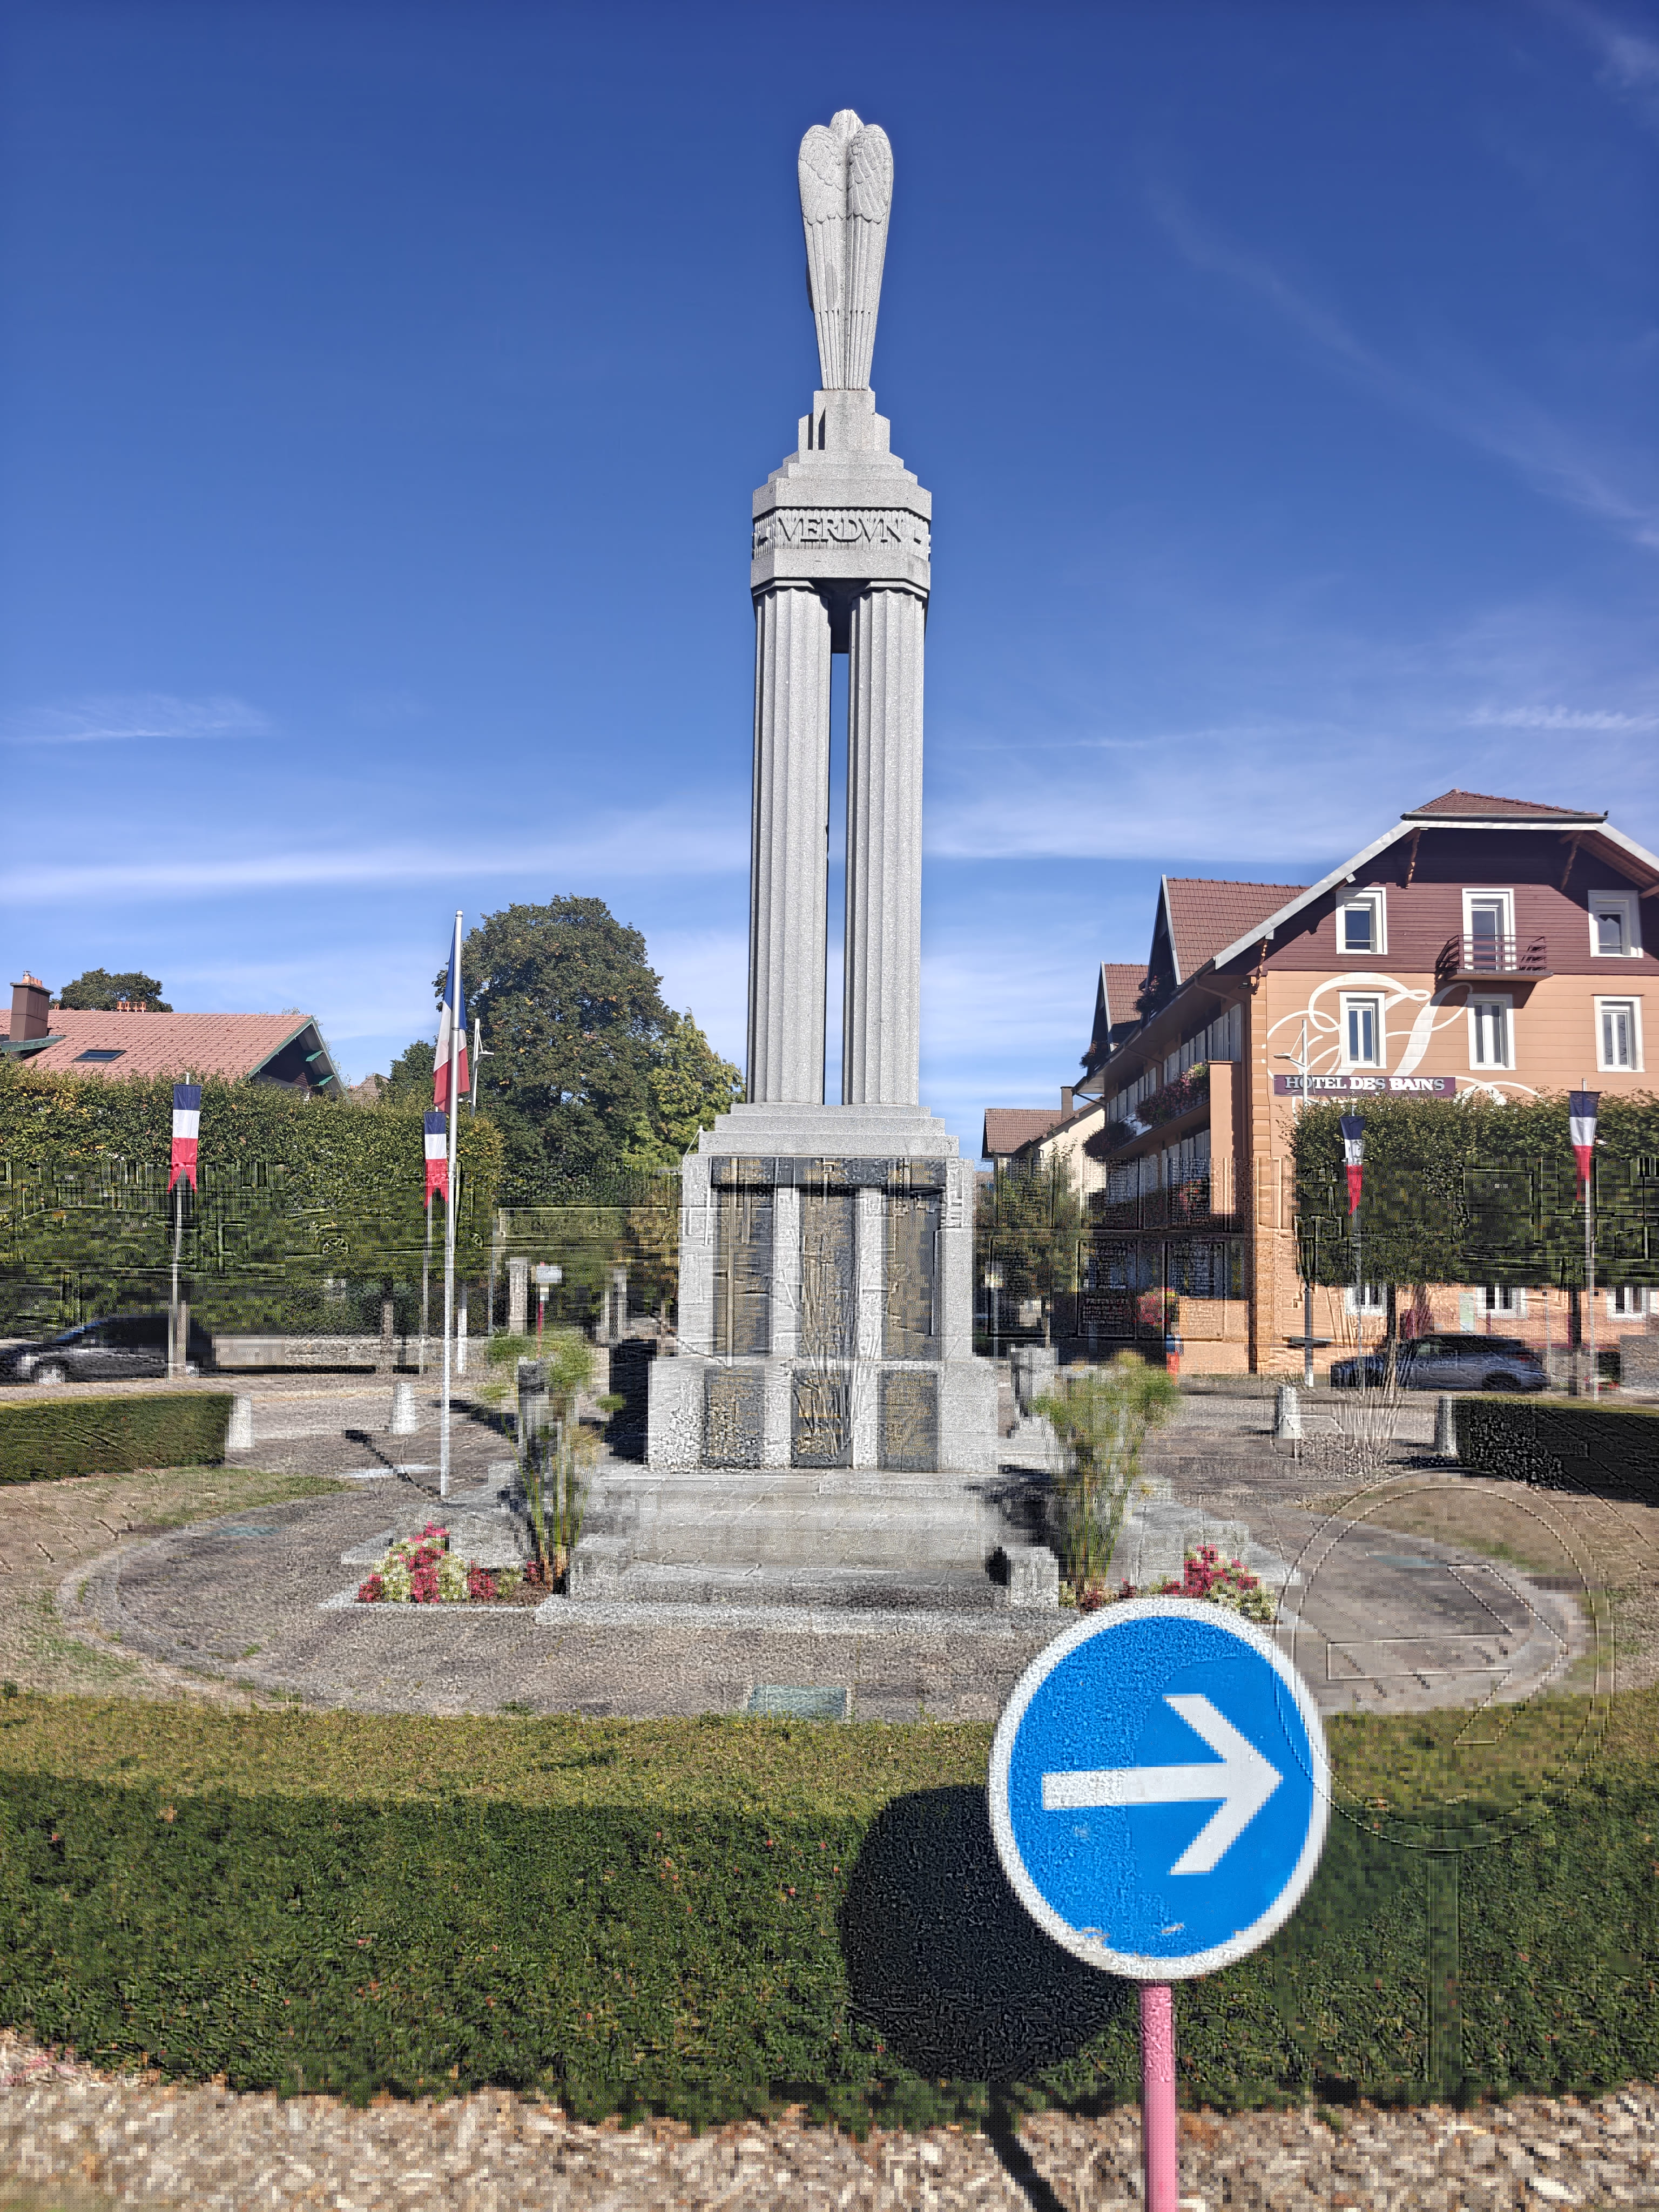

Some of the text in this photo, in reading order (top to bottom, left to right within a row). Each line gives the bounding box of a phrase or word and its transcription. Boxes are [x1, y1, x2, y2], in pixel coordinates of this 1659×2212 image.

[1285, 1076, 1445, 1091] HOTEL DES BAINS
